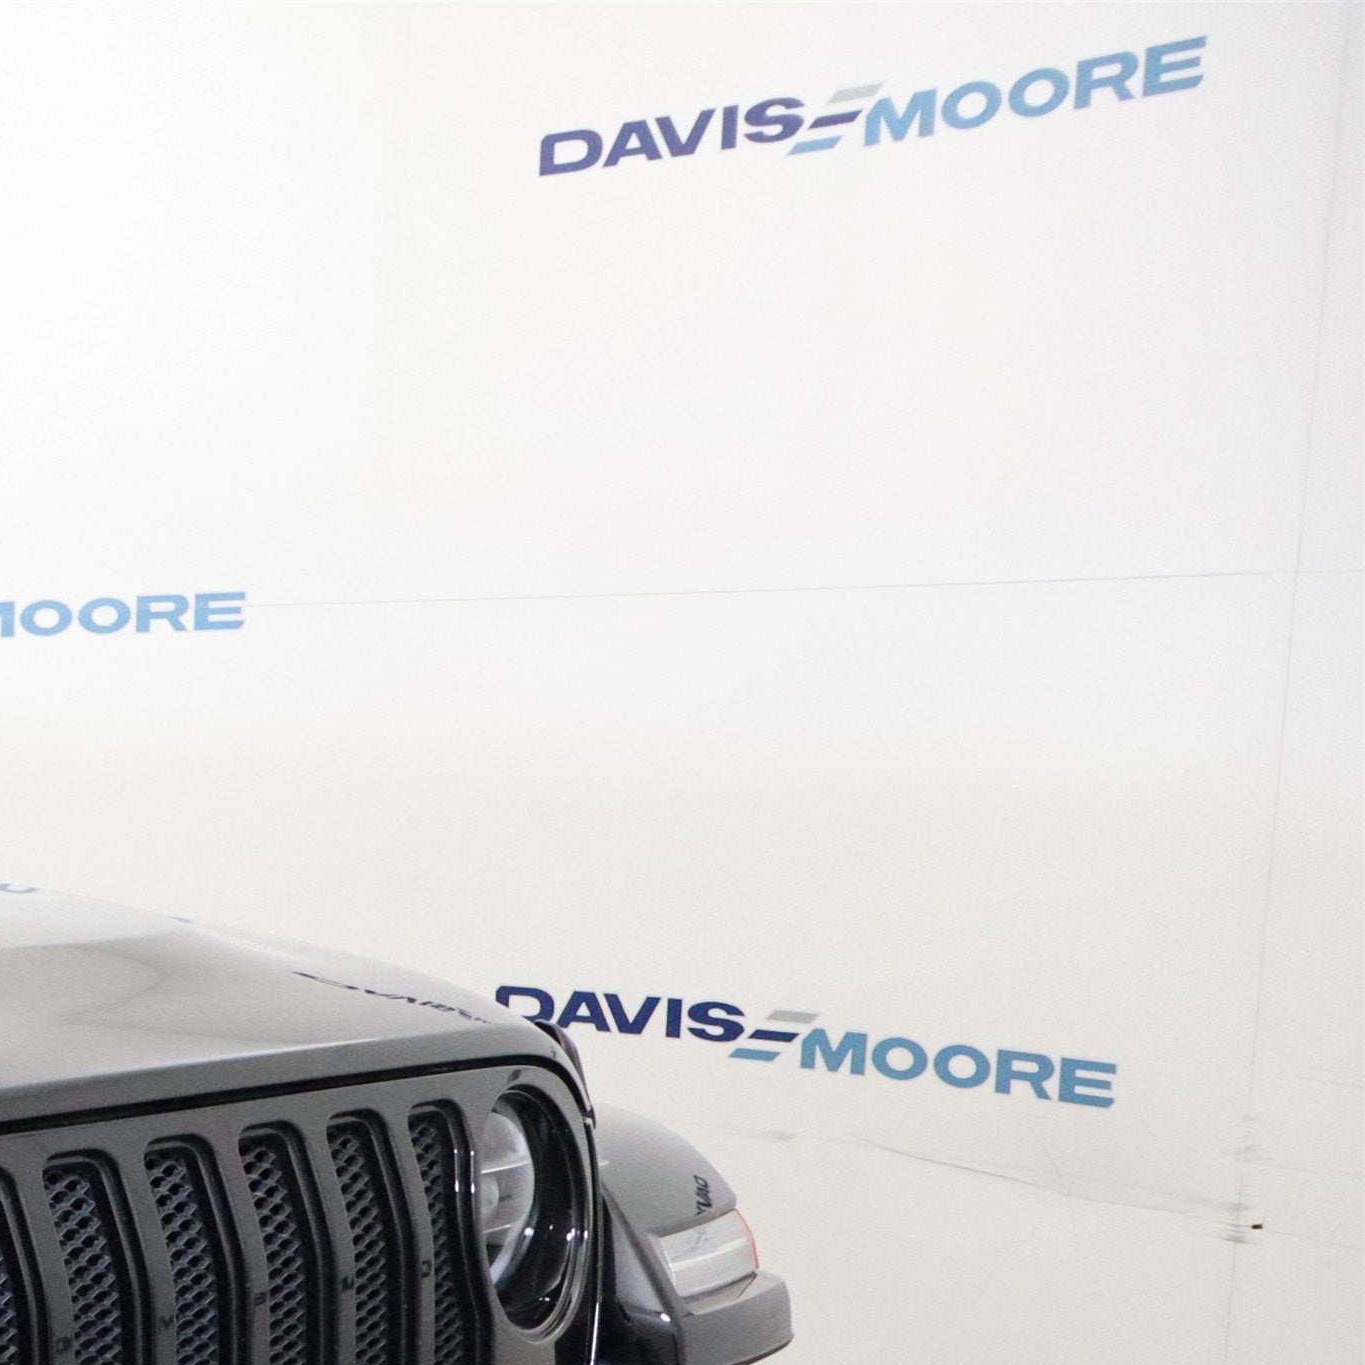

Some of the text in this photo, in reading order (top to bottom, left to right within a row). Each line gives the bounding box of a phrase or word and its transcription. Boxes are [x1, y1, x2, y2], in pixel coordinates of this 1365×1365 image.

[538, 35, 1207, 177] DAVIS MOORE
[495, 985, 745, 1043] DAVIS
[801, 1028, 1117, 1108] MOORE
